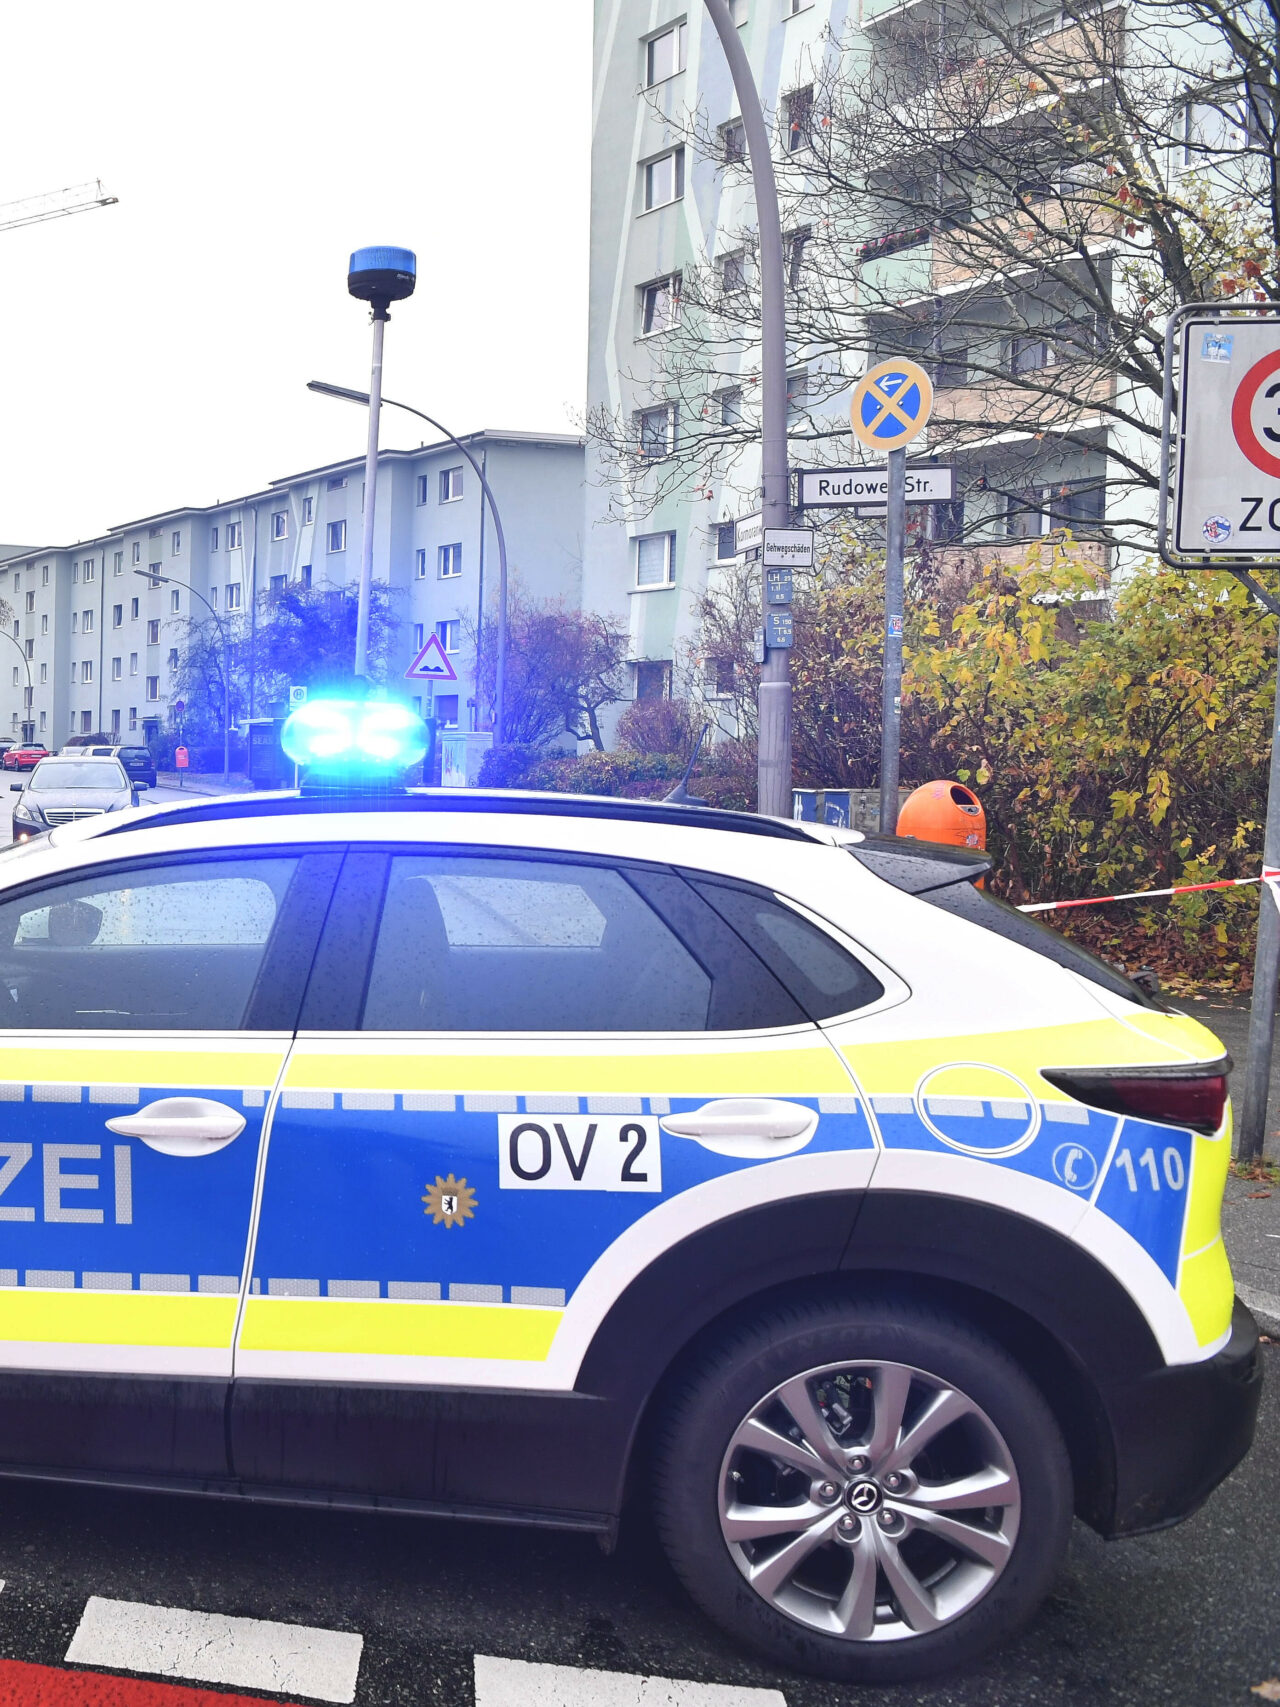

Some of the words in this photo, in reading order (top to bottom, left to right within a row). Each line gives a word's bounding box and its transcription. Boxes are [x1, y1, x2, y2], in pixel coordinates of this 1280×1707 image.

[819, 478, 888, 496] Rudowe
[904, 475, 934, 493] Str.
[766, 542, 811, 555] Gehwegschäden
[509, 1122, 598, 1181] OV
[619, 1123, 648, 1182] 2
[1115, 1147, 1185, 1192] 110
